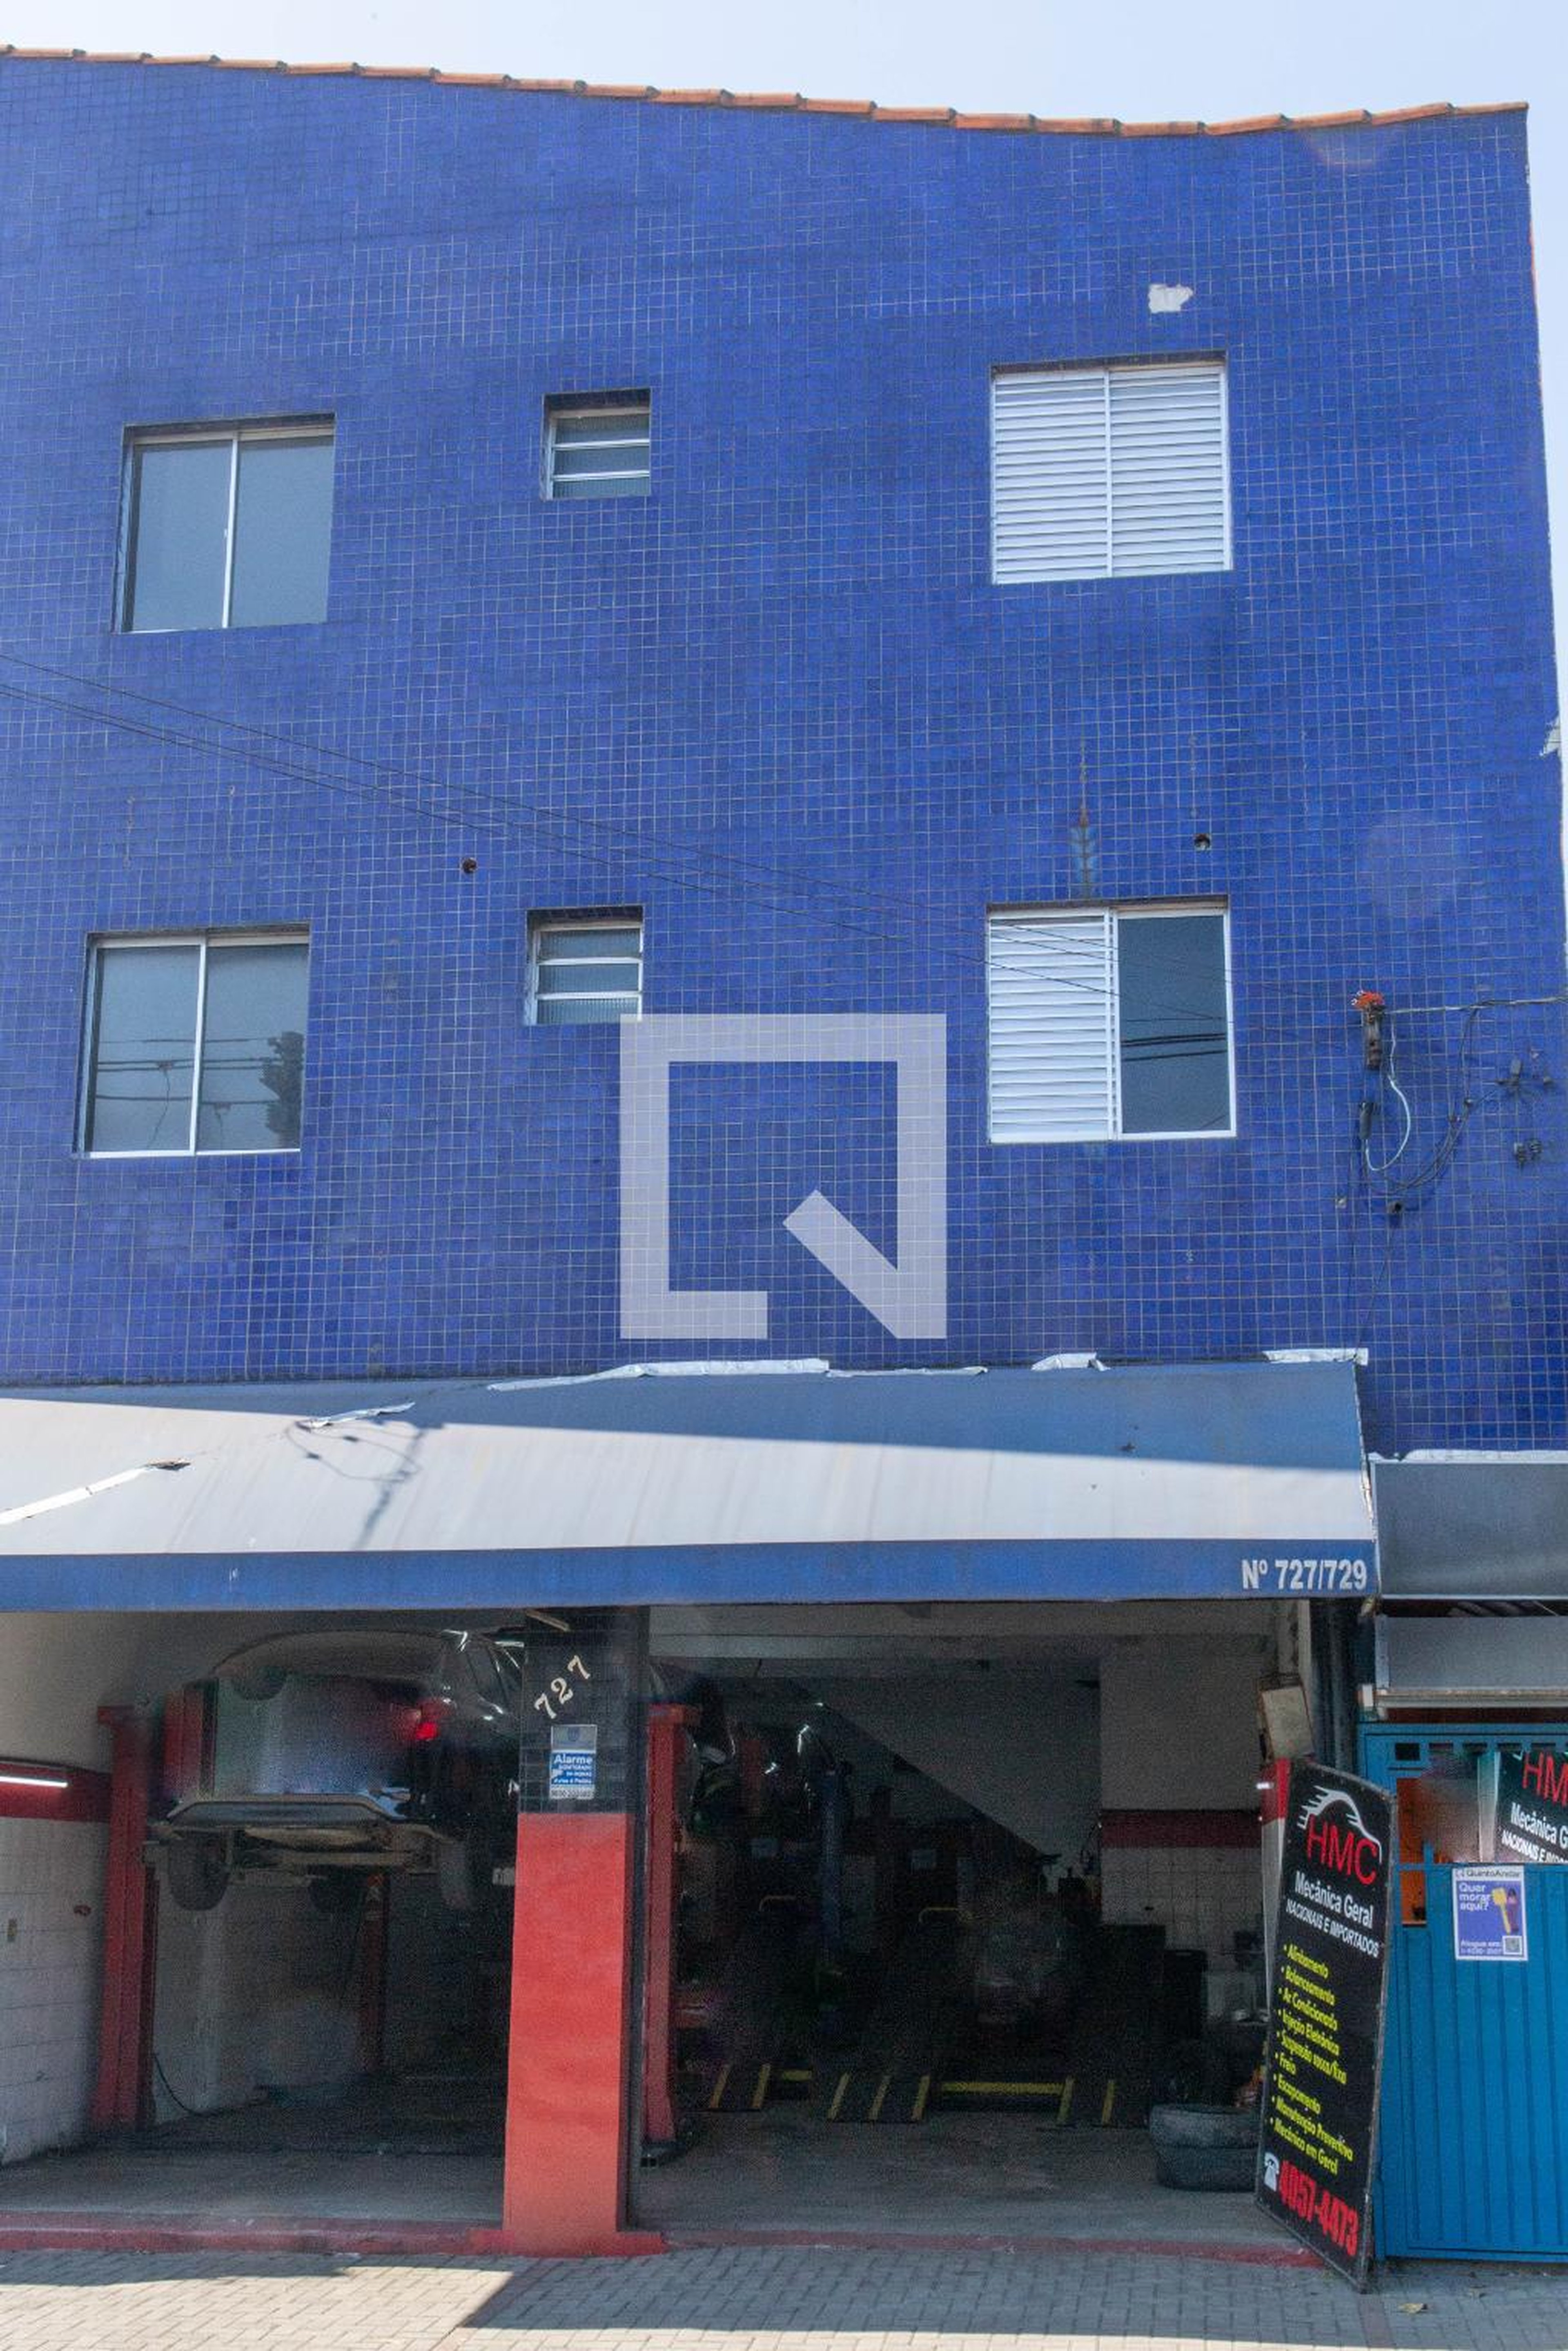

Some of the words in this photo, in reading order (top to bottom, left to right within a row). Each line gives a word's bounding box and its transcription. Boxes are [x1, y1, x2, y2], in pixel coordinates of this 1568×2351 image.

[1275, 1559, 1367, 1590] 727/729
[534, 1655, 590, 1719] 727
[554, 1753, 592, 1764] Alarme
[1307, 1813, 1376, 1885] HMC
[1501, 1830, 1539, 1860] NACIONAIS
[1295, 1871, 1341, 1913] Mecânica
[1344, 1894, 1373, 1929] Geral
[1459, 1882, 1486, 1892] Quer
[1460, 1901, 1489, 1911] aqui?
[1286, 1899, 1323, 1929] NACIONAIS
[1323, 1917, 1330, 1933] E
[1330, 1921, 1379, 1958] IMPORTADOS
[1287, 1944, 1328, 1978] Alinhamento
[1286, 1965, 1334, 2006] Balanceamento
[1283, 1988, 1292, 2003] Ar
[1292, 1992, 1337, 2031] Condicionado
[1280, 2052, 1296, 2074] Freio
[1278, 2073, 1320, 2114] Escapamento
[1276, 2095, 1316, 2135] Manutenção
[1317, 2123, 1353, 2161] Preventiva
[1306, 2144, 1317, 2159] em
[1319, 2148, 1338, 2175] Geral
